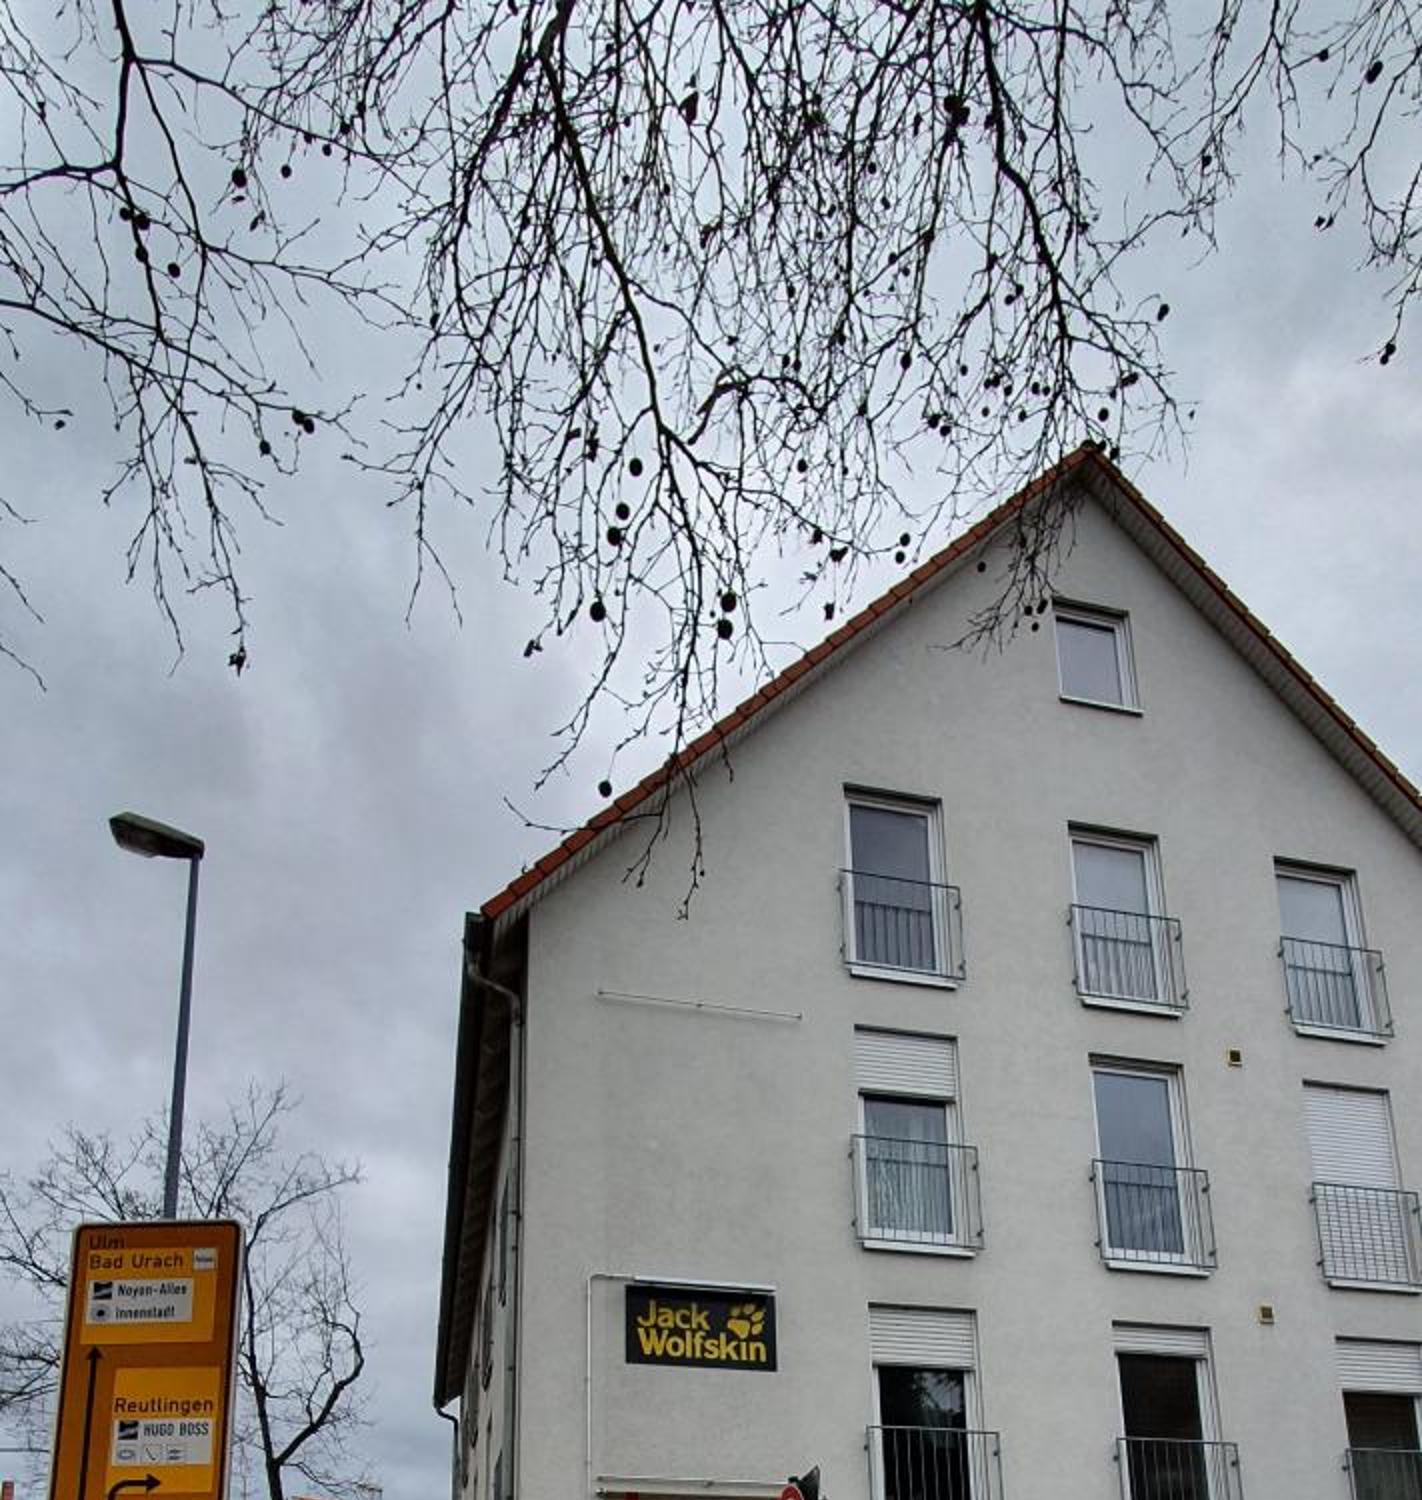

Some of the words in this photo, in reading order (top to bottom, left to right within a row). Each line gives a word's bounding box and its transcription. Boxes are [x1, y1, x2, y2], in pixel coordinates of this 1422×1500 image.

[89, 1235, 126, 1249] Ulm
[89, 1254, 123, 1269] Bad
[131, 1253, 184, 1268] Urach
[637, 1299, 711, 1329] Jack
[637, 1327, 767, 1362] Wolfskin
[114, 1398, 214, 1416] Reutlingen
[143, 1424, 174, 1437] HUGO
[180, 1422, 209, 1436] BOSS
